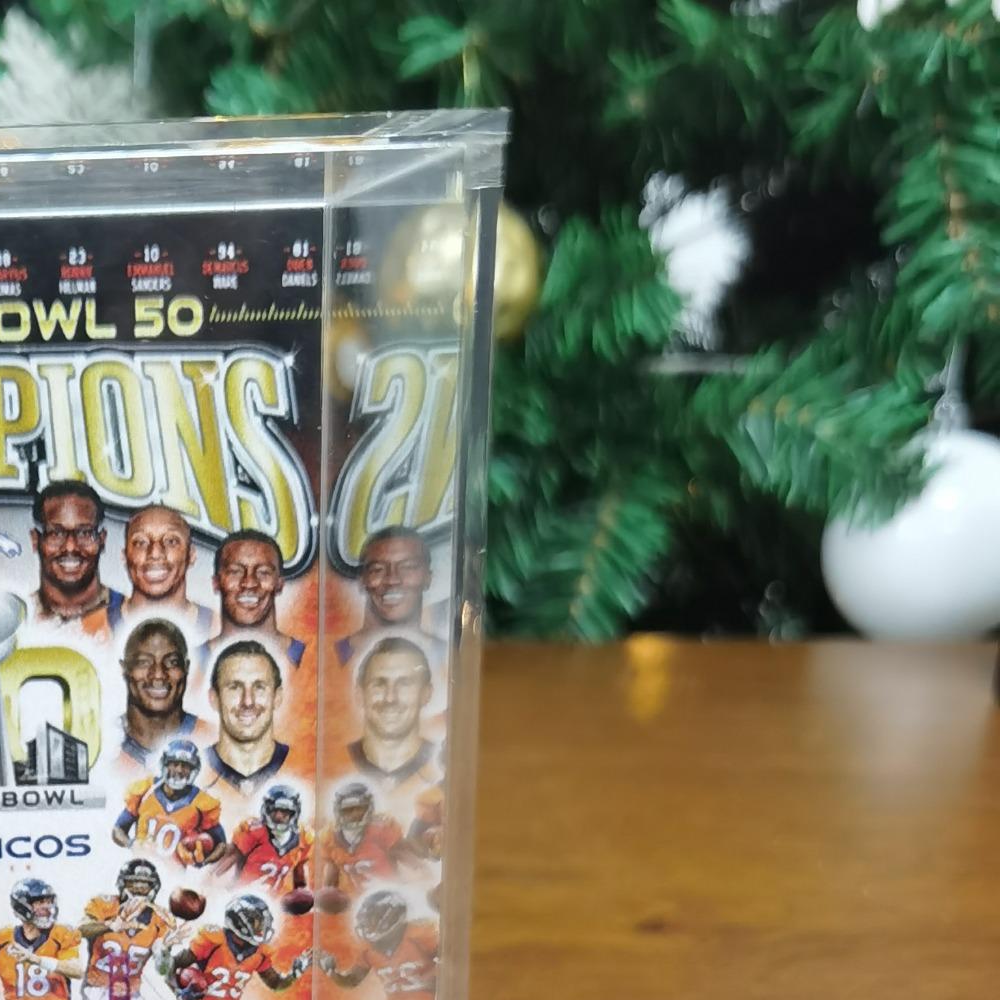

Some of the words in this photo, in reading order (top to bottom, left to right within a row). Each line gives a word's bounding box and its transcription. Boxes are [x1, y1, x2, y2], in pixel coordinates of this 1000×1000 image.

[134, 295, 204, 337] 50
[2, 789, 84, 808] BOWL
[16, 964, 50, 997] 18
[208, 967, 250, 999] 23
